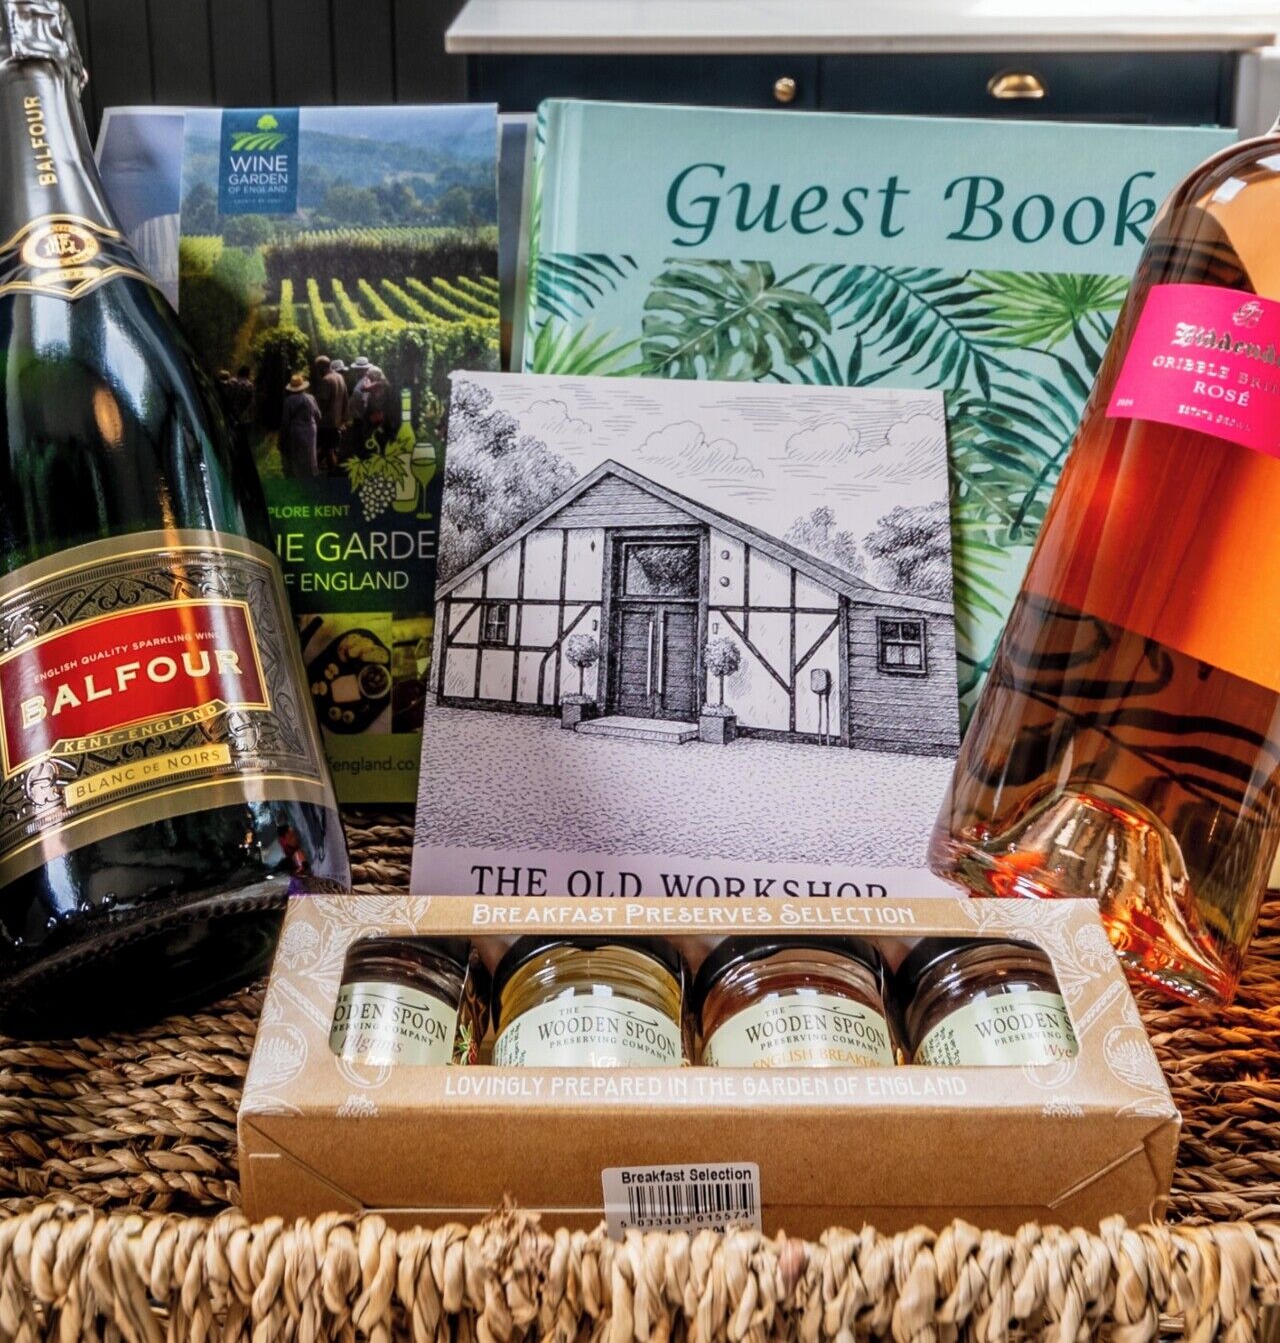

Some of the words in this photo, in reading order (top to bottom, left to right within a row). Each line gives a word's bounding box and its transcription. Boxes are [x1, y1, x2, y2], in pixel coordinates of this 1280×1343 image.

[23, 96, 58, 186] BALFOUR
[229, 155, 288, 172] WINE
[228, 173, 288, 185] GARDEN
[228, 186, 240, 194] OF
[243, 186, 287, 194] ENGLAND
[665, 162, 912, 248] Guest
[943, 170, 1156, 246] Book
[1152, 355, 1231, 379] GRIBBLE
[1192, 380, 1251, 407] ROSÉ
[267, 505, 310, 518] PLORE
[314, 505, 350, 517] KENT
[315, 530, 436, 562] GARDE
[301, 571, 410, 592] ENGLAND
[33, 660, 78, 685] ENGLISH
[81, 645, 129, 665] QUALITY
[132, 633, 193, 651] SPARKLING
[20, 649, 243, 730] BALFOUR
[76, 768, 136, 798] BLANC
[143, 763, 160, 775] DE
[167, 749, 221, 769] NOIRS
[470, 865, 548, 896] THE
[567, 869, 643, 897] OLD
[472, 903, 618, 925] BREAKFAST
[625, 903, 772, 925] PRESERVES
[779, 903, 917, 925] SELECTION
[559, 1007, 580, 1016] THE
[764, 1007, 785, 1017] THE
[994, 1004, 1015, 1014] THE
[333, 1003, 385, 1022] ODEN
[391, 1008, 448, 1043] SPOON
[745, 1014, 828, 1043] WOODEN
[833, 1016, 887, 1049] SPOON
[974, 1012, 1060, 1039] WOODEN
[538, 1016, 620, 1041] WOODEN
[625, 1021, 677, 1057] SPOON
[760, 1034, 828, 1051] PRESERVING
[832, 1034, 879, 1054] COMPANY
[994, 1030, 1062, 1047] PRESERVING
[549, 1036, 618, 1049] PRESERVING
[622, 1039, 668, 1063] COMPANY
[821, 1048, 881, 1068] BREAKFA
[445, 1075, 544, 1097] LOVINGLY
[551, 1076, 662, 1097] PREPARED
[669, 1076, 687, 1097] IN
[695, 1076, 736, 1097] THE
[742, 1076, 828, 1097] GARDEN
[834, 1076, 860, 1097] OF
[867, 1075, 967, 1097] ENGLAND
[621, 1169, 685, 1184] Breakfast
[689, 1167, 752, 1181] Selection
